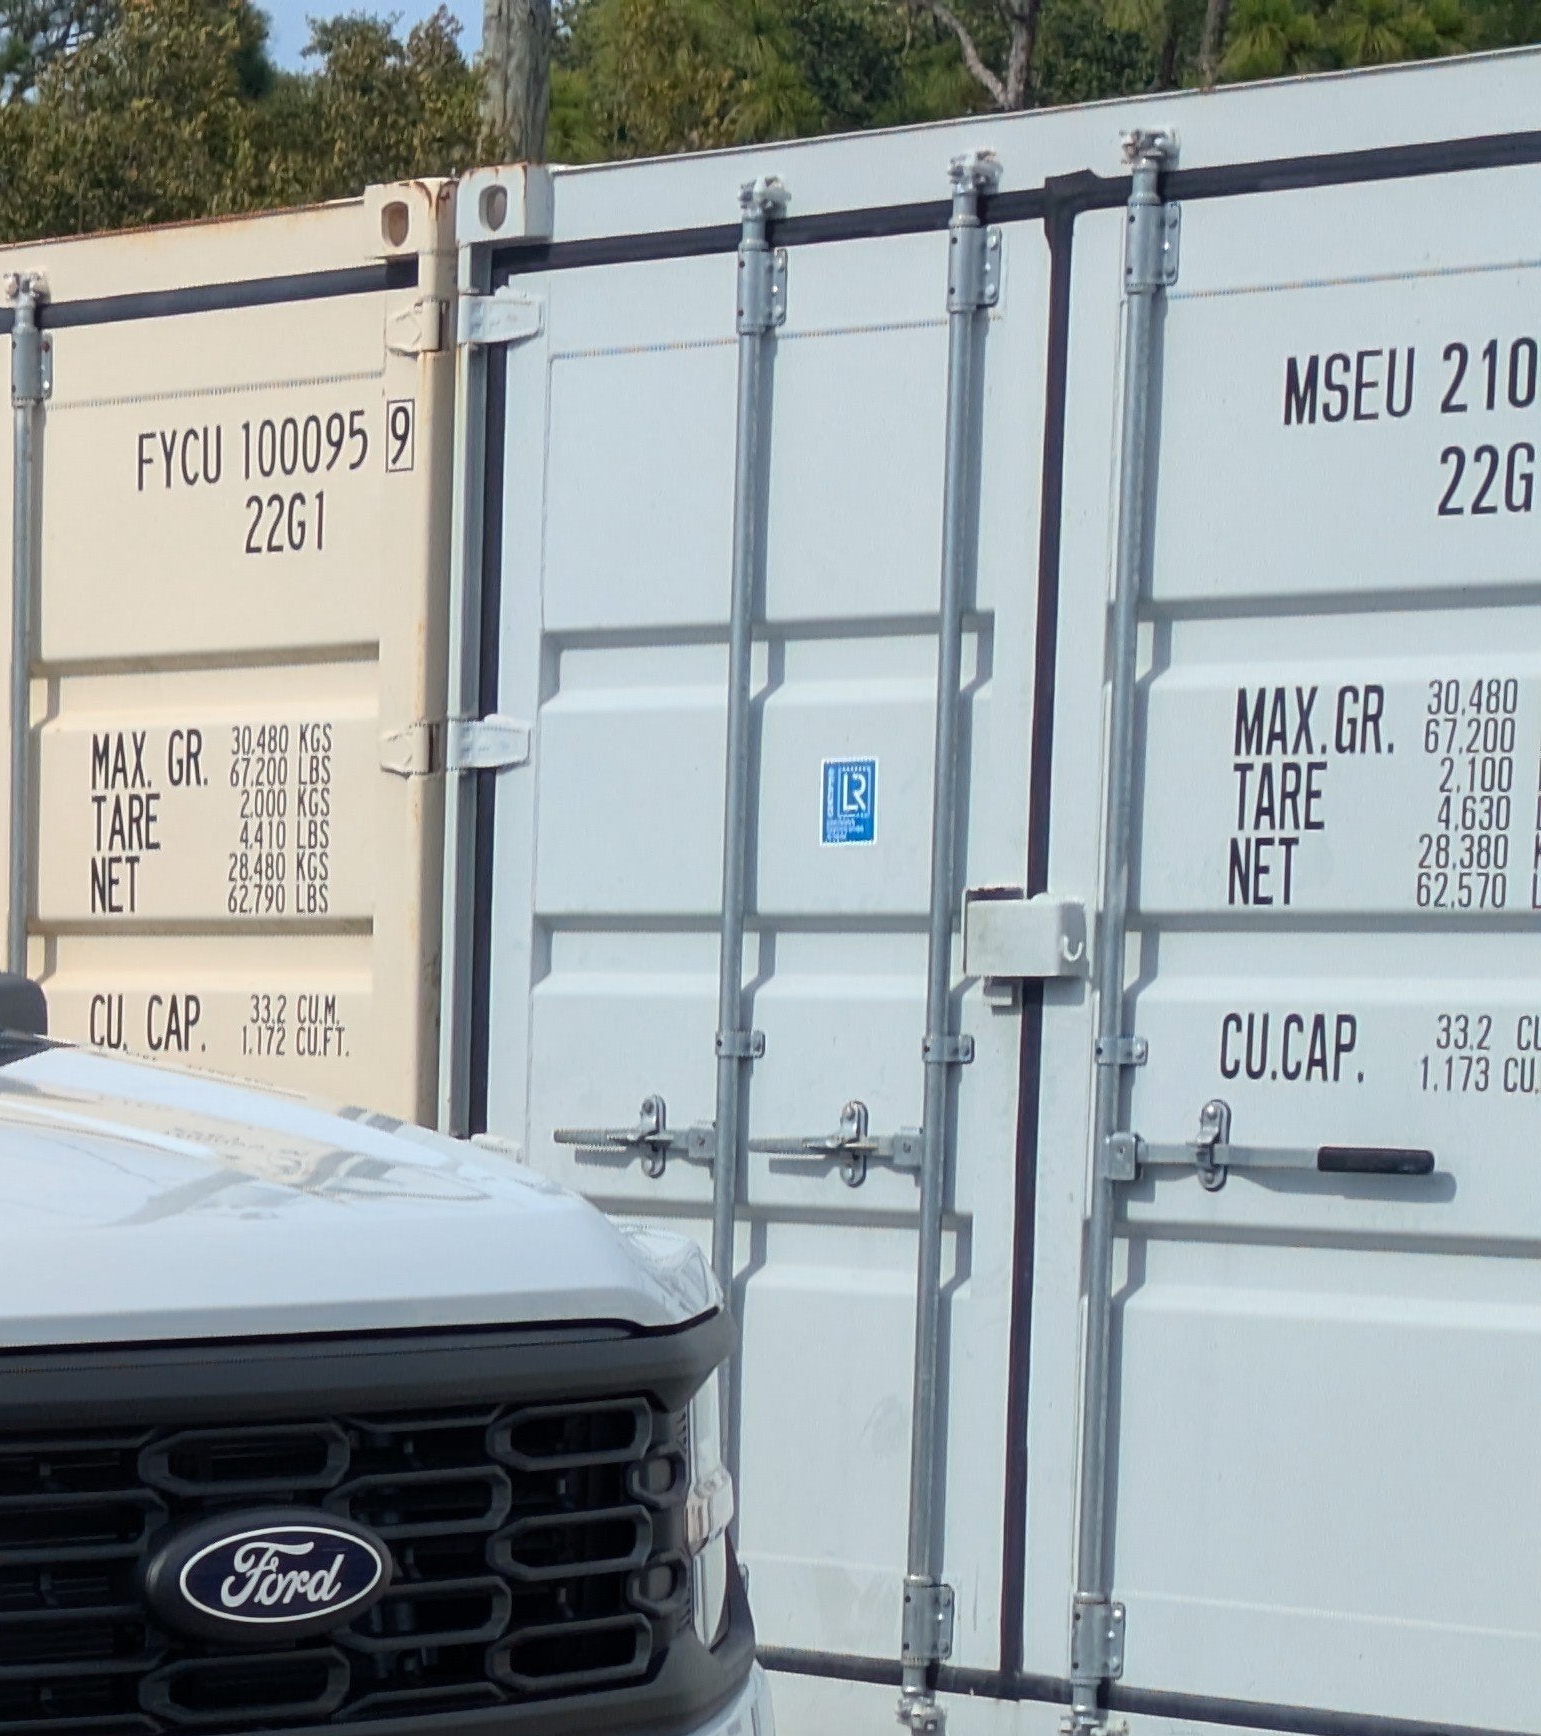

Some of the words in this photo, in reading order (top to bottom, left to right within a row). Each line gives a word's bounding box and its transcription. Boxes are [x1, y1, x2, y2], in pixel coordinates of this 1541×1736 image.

[1283, 347, 1415, 426] MSEU
[1440, 336, 1538, 414] 210
[137, 424, 221, 491] FYCU
[241, 409, 368, 480] 100095
[390, 406, 410, 465] 9
[1437, 442, 1535, 516] 22G
[245, 490, 325, 553] 22G1
[91, 731, 152, 790] MAX.
[168, 728, 208, 787] GR.
[299, 723, 332, 754] KGS
[298, 755, 331, 786] LBS
[1233, 761, 1328, 831] TARE
[91, 793, 161, 851] TARE
[297, 787, 330, 818] KGS
[296, 819, 329, 850] LBS
[91, 855, 141, 914] NET
[296, 851, 329, 882] KGS
[1228, 837, 1300, 906] NET
[296, 883, 328, 914] LBS
[147, 994, 206, 1052] CAP.
[1436, 1014, 1492, 1051] 33.2
[220, 1541, 345, 1608] Ford
